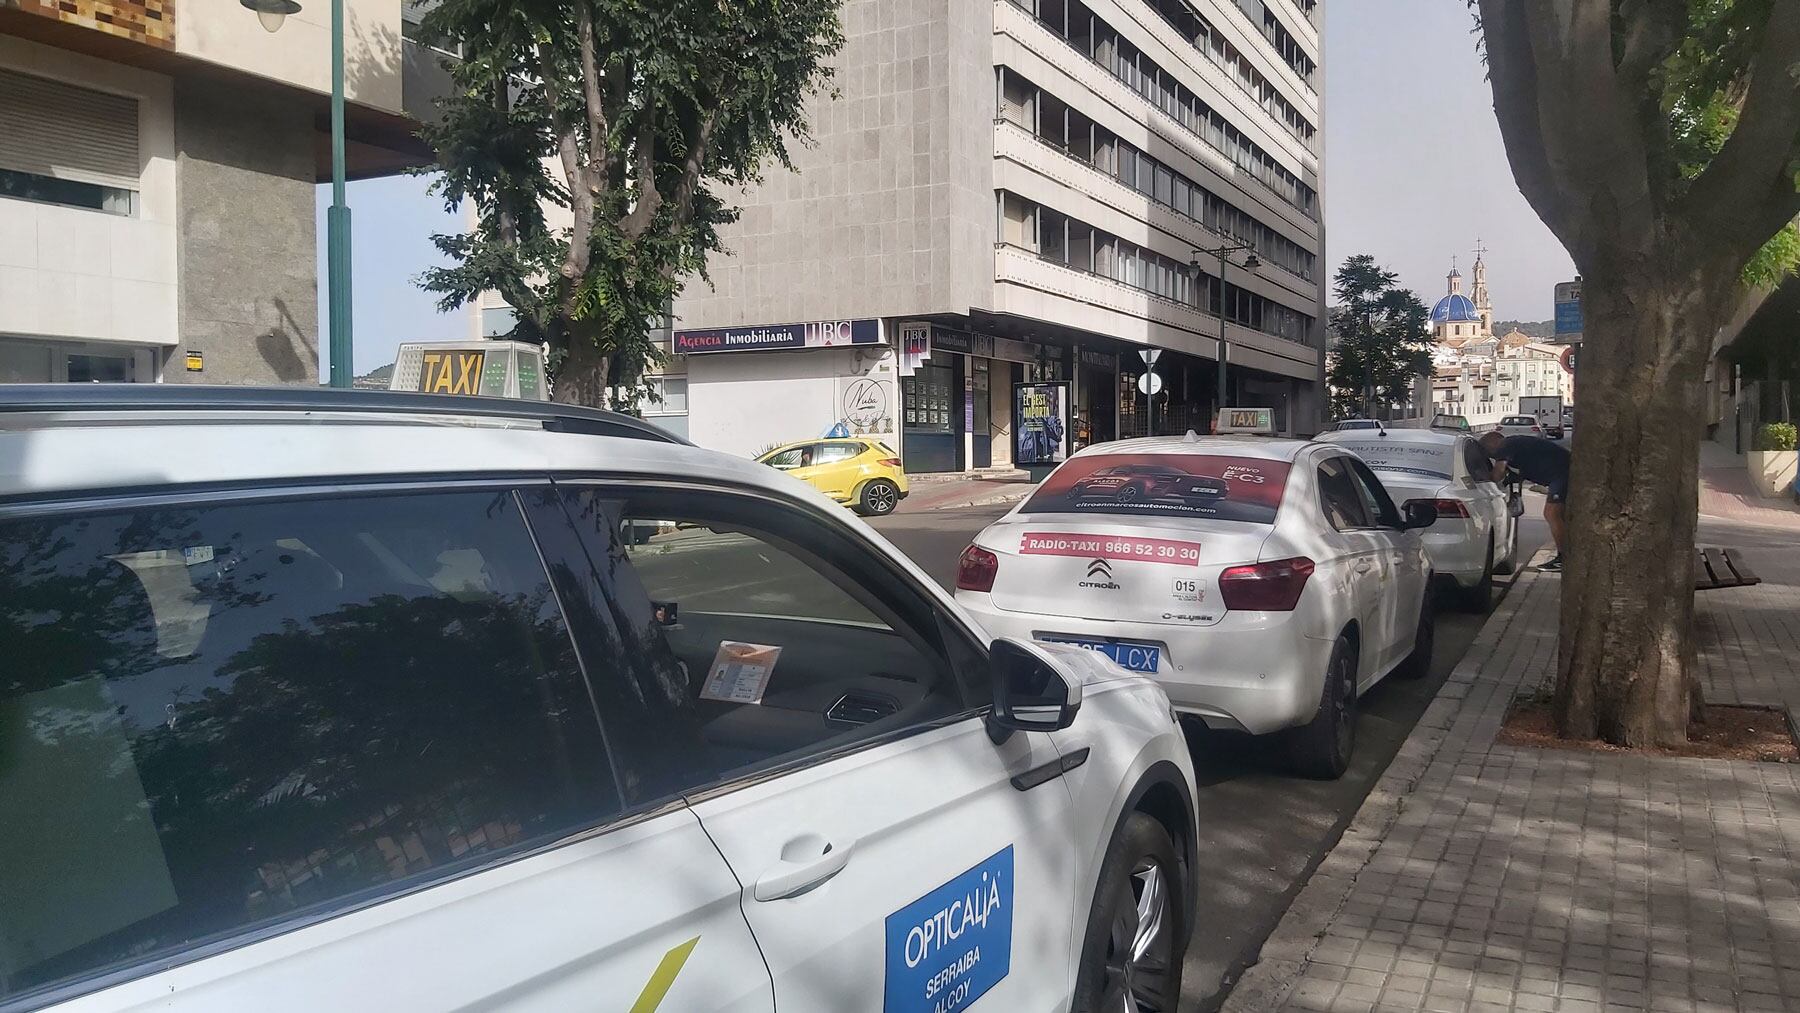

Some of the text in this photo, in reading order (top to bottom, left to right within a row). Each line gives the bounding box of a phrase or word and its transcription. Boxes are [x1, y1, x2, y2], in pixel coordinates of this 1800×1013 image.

[423, 354, 484, 395] TAXI
[1023, 406, 1050, 418] IMPORTA
[1231, 411, 1257, 426] TAXI
[1226, 465, 1260, 473] NUEVO
[1029, 538, 1199, 560] RADIO-TAXI 966 52 30 30
[1175, 580, 1196, 592] 015
[1114, 646, 1156, 671] LCX
[926, 945, 980, 1000] SERRAIBA
[934, 977, 972, 1013] ALCOY
